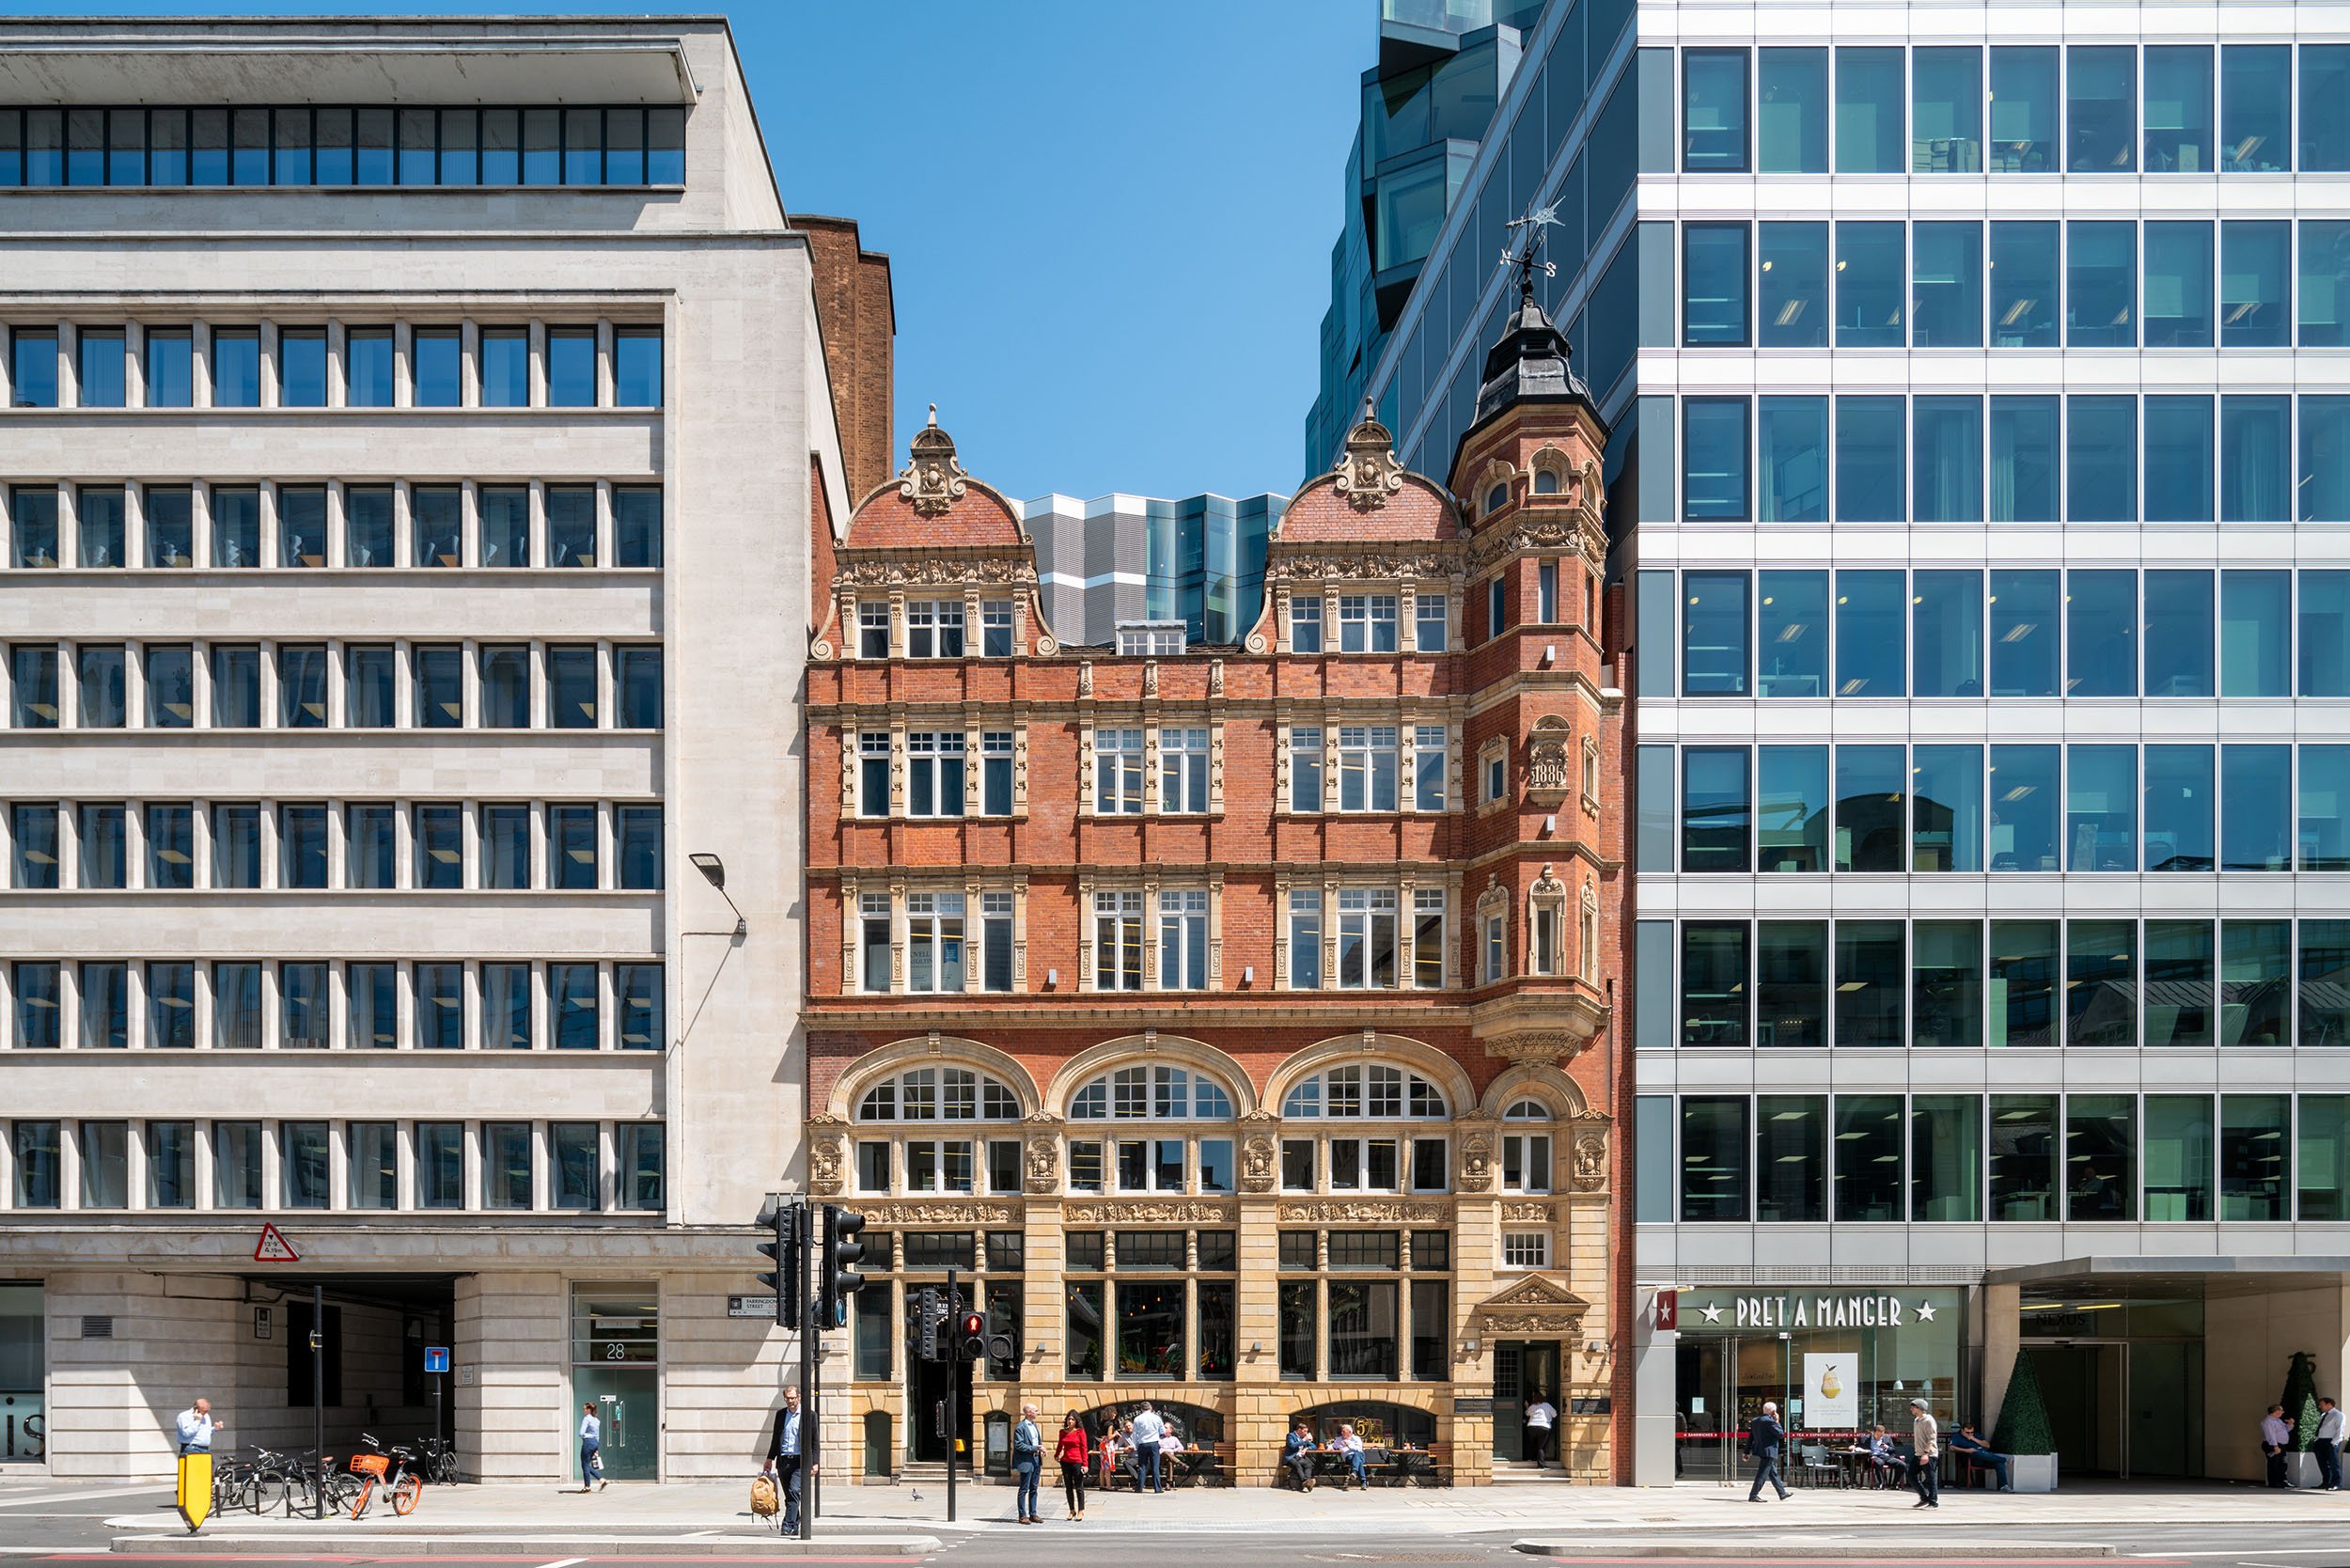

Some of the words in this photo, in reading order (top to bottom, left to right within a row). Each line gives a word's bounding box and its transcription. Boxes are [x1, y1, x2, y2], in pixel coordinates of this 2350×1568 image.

[1736, 1296, 1786, 1326] PRET
[1794, 1296, 1808, 1326] A
[1816, 1296, 1902, 1326] MANGER
[2036, 1313, 2085, 1325] NEXUS
[606, 1343, 625, 1359] 28
